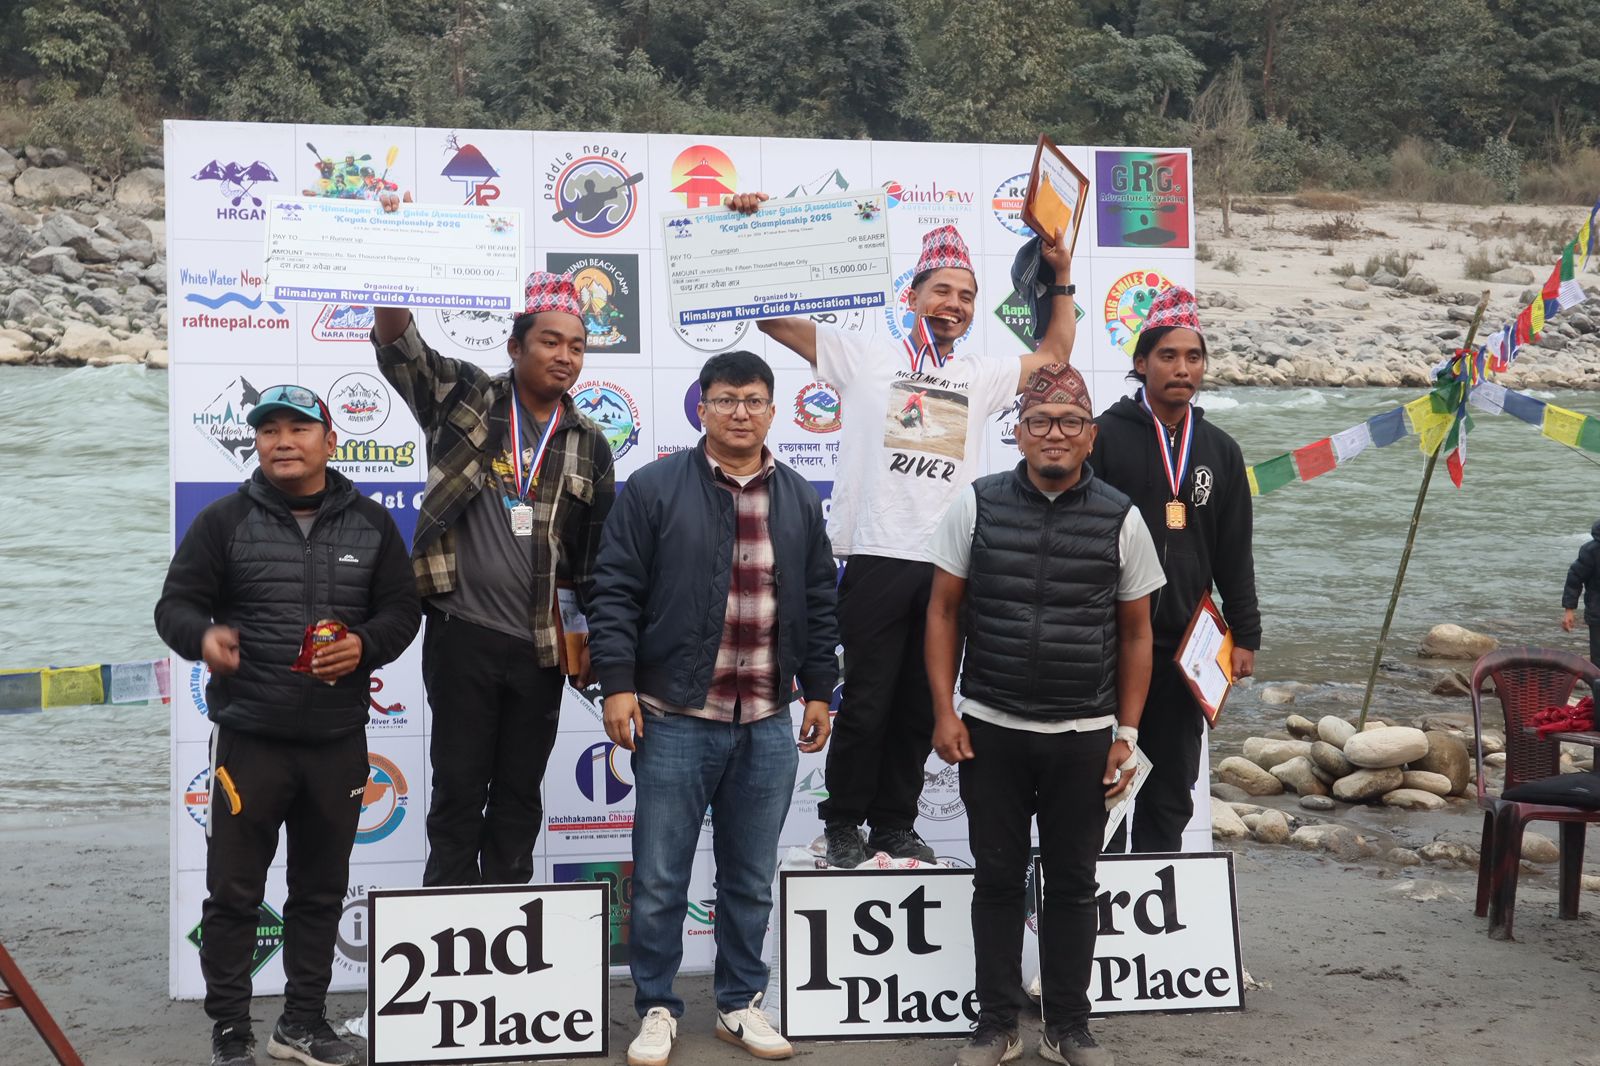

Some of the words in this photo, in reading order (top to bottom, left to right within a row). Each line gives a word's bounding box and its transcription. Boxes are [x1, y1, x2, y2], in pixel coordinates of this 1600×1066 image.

[544, 151, 573, 200] paddle
[584, 144, 628, 163] nepal
[1100, 192, 1144, 202] Adventure
[1146, 194, 1184, 204] Kayaking
[704, 212, 748, 222] Himalaya
[780, 206, 802, 216] Guide
[806, 200, 852, 212] Association
[334, 216, 367, 224] Kayak
[370, 217, 434, 228] Championship
[720, 222, 748, 232] Kayak
[750, 216, 808, 230] Championship
[180, 268, 208, 286] White
[208, 268, 237, 286] Water
[564, 259, 588, 277] UNDI
[588, 258, 616, 274] BEACH
[614, 271, 629, 295] CAMP
[829, 263, 868, 274] 15,000.00
[278, 287, 336, 300] Himalayan
[340, 289, 369, 301] River
[372, 292, 404, 302] Guide
[408, 294, 474, 304] Association
[476, 297, 507, 307] Nepal
[754, 292, 788, 302] Organized
[683, 309, 732, 322] Himalayan
[735, 306, 760, 316] River
[763, 303, 791, 313] Guide
[794, 298, 851, 311] Association
[854, 295, 882, 306] Nepal
[1106, 304, 1118, 320] BIG
[182, 314, 290, 331] raftnepal.com
[924, 375, 936, 385] ME
[940, 379, 950, 389] AT
[578, 380, 600, 391] RURAL
[602, 380, 640, 420] MUNICIPALITY
[210, 424, 242, 438] Outdoor
[890, 453, 955, 482] RIVER
[370, 491, 405, 509] 1st
[190, 668, 208, 716] EDUCATION
[548, 815, 606, 824] Ichchhakamana
[1096, 864, 1186, 936] rd
[258, 938, 280, 946] ons
[794, 885, 942, 991] 1st
[377, 897, 553, 1016] 2nd
[1095, 954, 1231, 1002] Place
[839, 974, 981, 1024] Place
[431, 995, 594, 1048] Place
